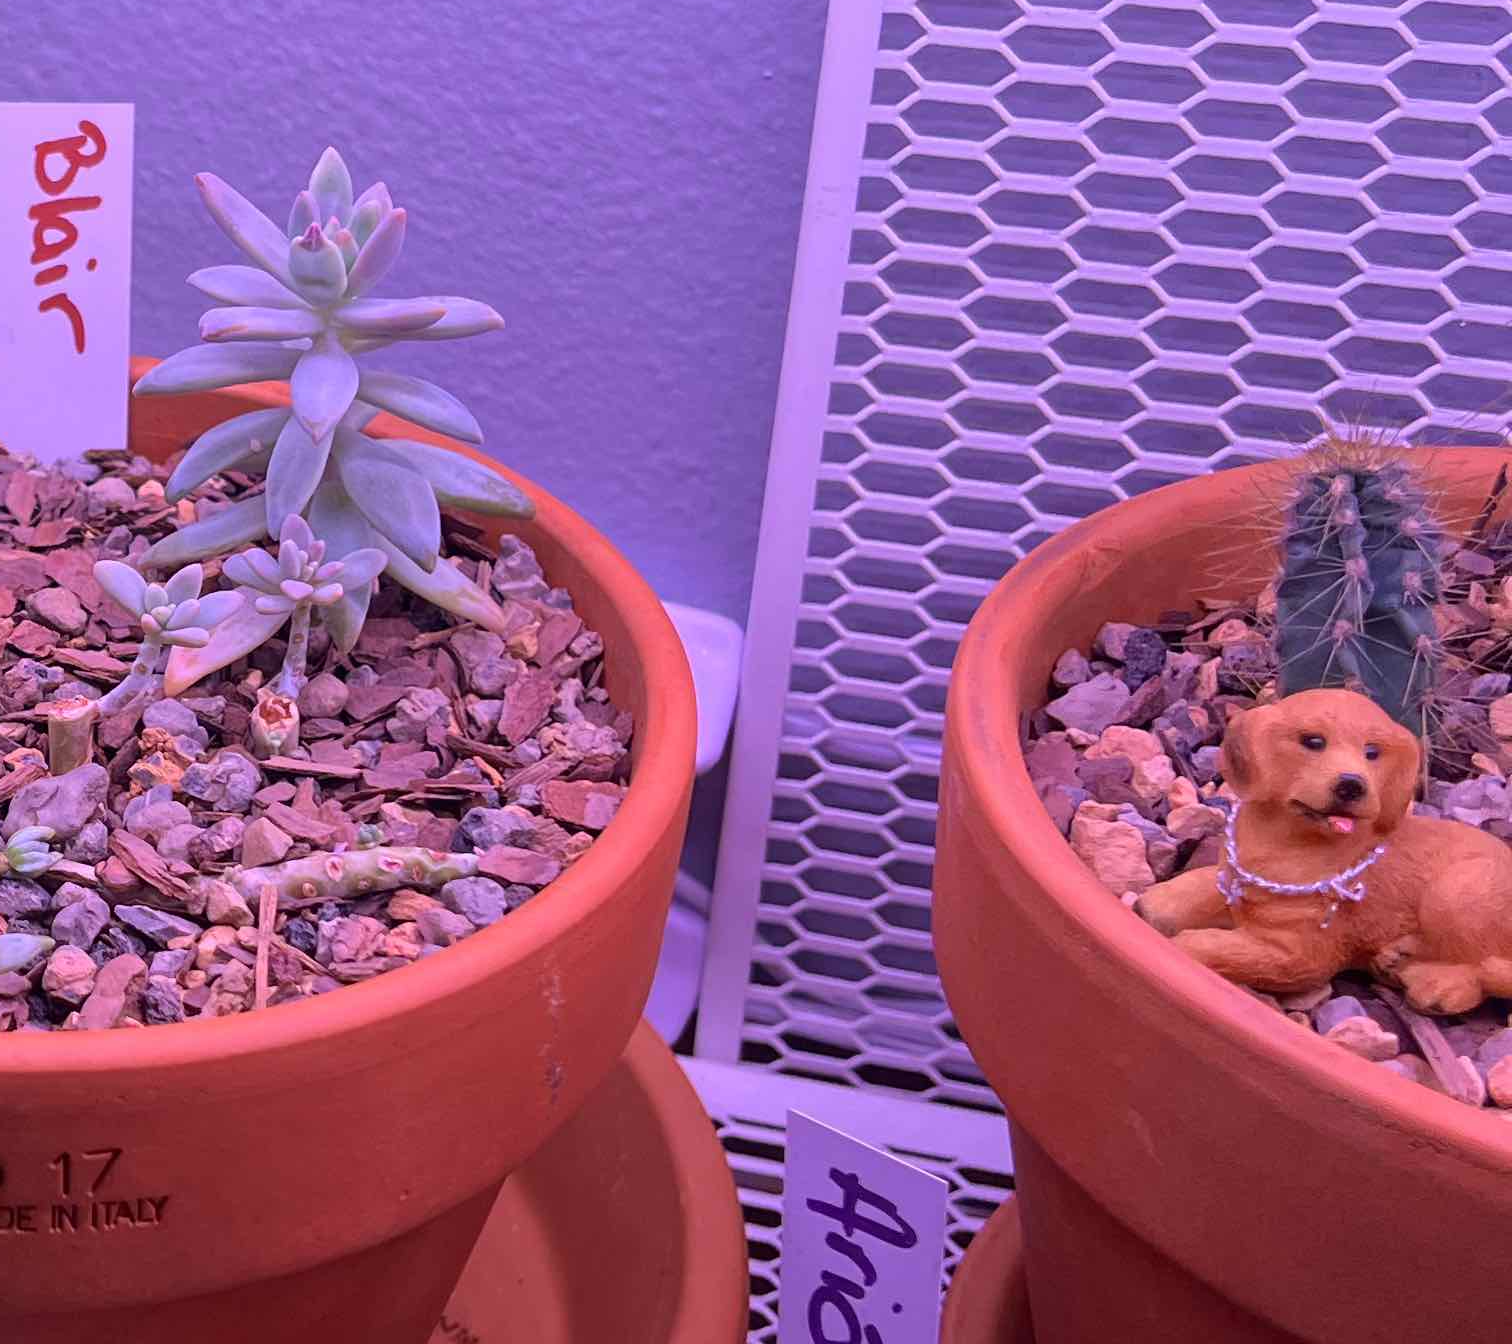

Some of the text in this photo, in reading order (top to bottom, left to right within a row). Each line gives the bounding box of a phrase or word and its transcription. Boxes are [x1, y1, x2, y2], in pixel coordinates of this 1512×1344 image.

[28, 119, 107, 354] Blair
[47, 1147, 123, 1197] 17
[49, 1203, 79, 1233] IN
[90, 1195, 170, 1230] ITALY
